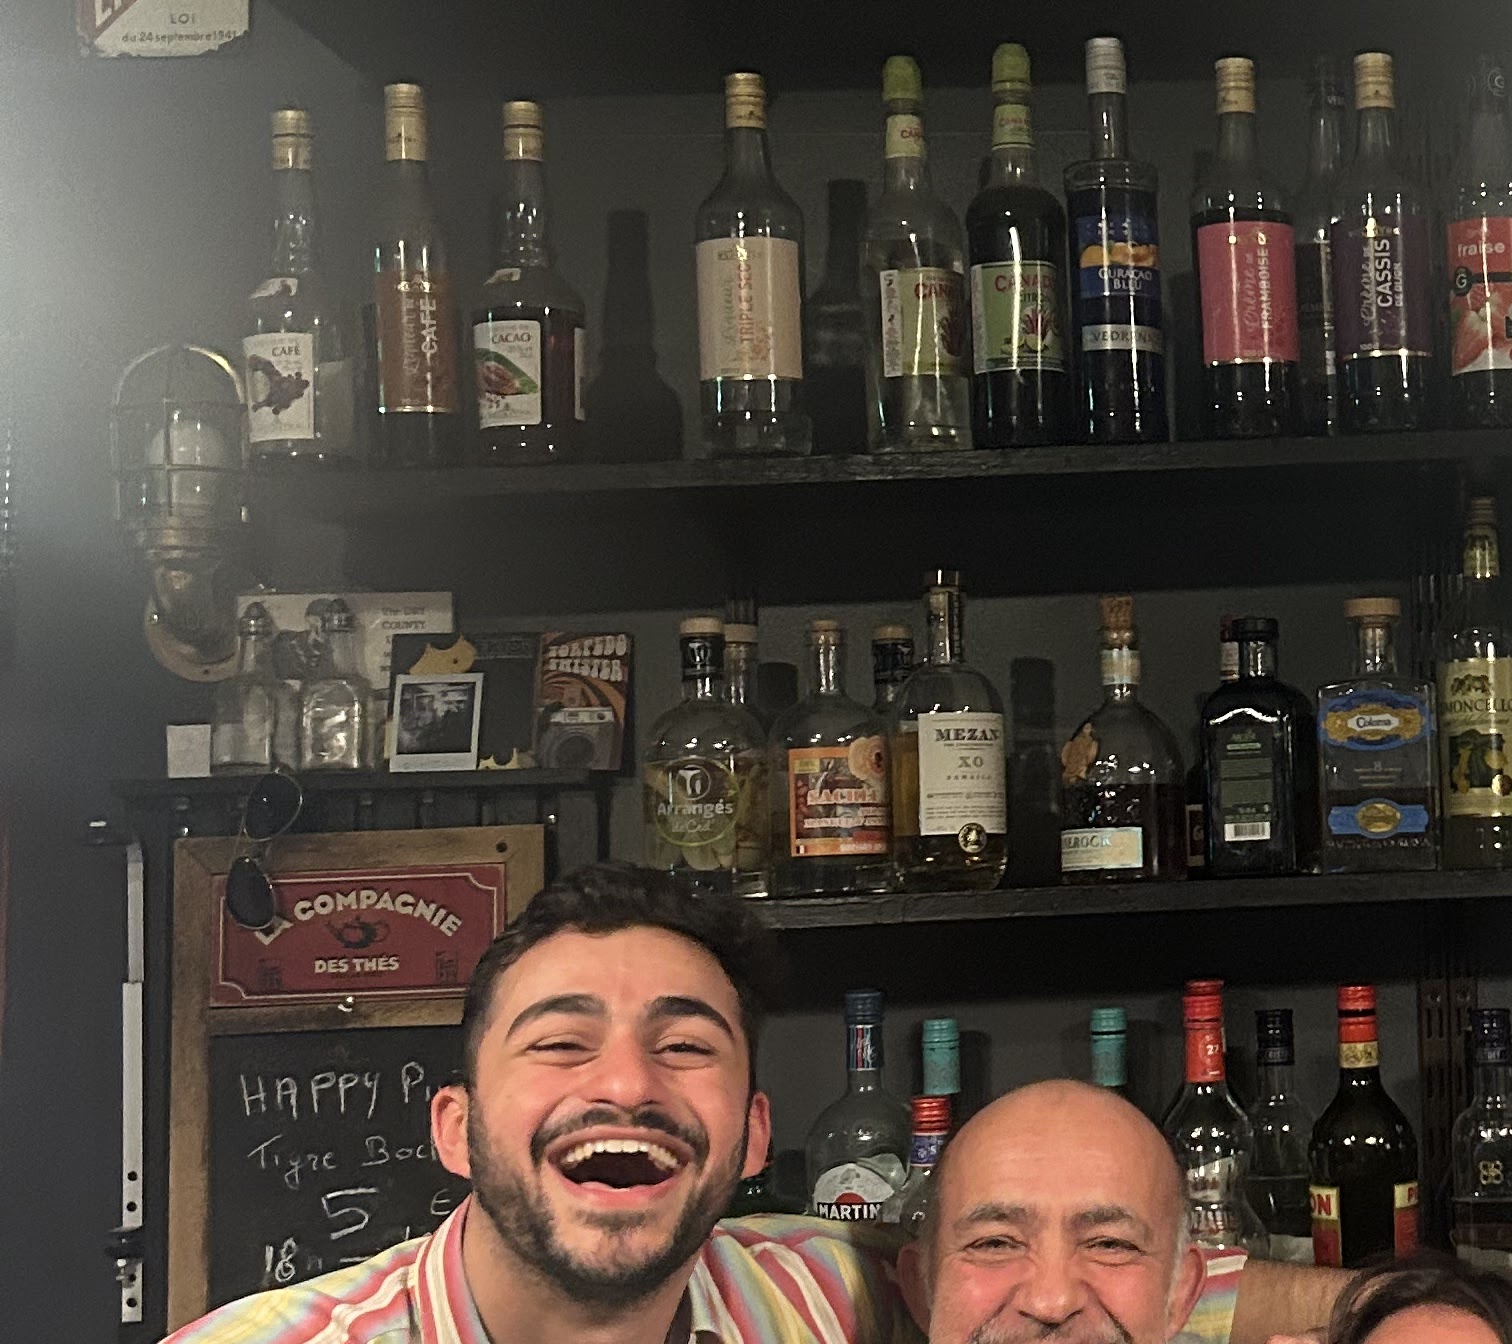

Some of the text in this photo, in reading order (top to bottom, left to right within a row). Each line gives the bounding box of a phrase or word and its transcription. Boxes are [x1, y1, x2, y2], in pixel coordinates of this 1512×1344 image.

[170, 12, 196, 25] LOI
[1456, 240, 1506, 257] fraise
[1373, 239, 1394, 308] CASSIS
[491, 331, 532, 344] CACAO
[957, 756, 984, 769] XO
[656, 800, 735, 820] Arrangés
[293, 889, 465, 938] COMPAGNIE
[312, 958, 350, 975] DES
[239, 1069, 382, 1121] HAPPY
[246, 1133, 338, 1191] Tigre
[818, 1203, 881, 1220] MARTIN
